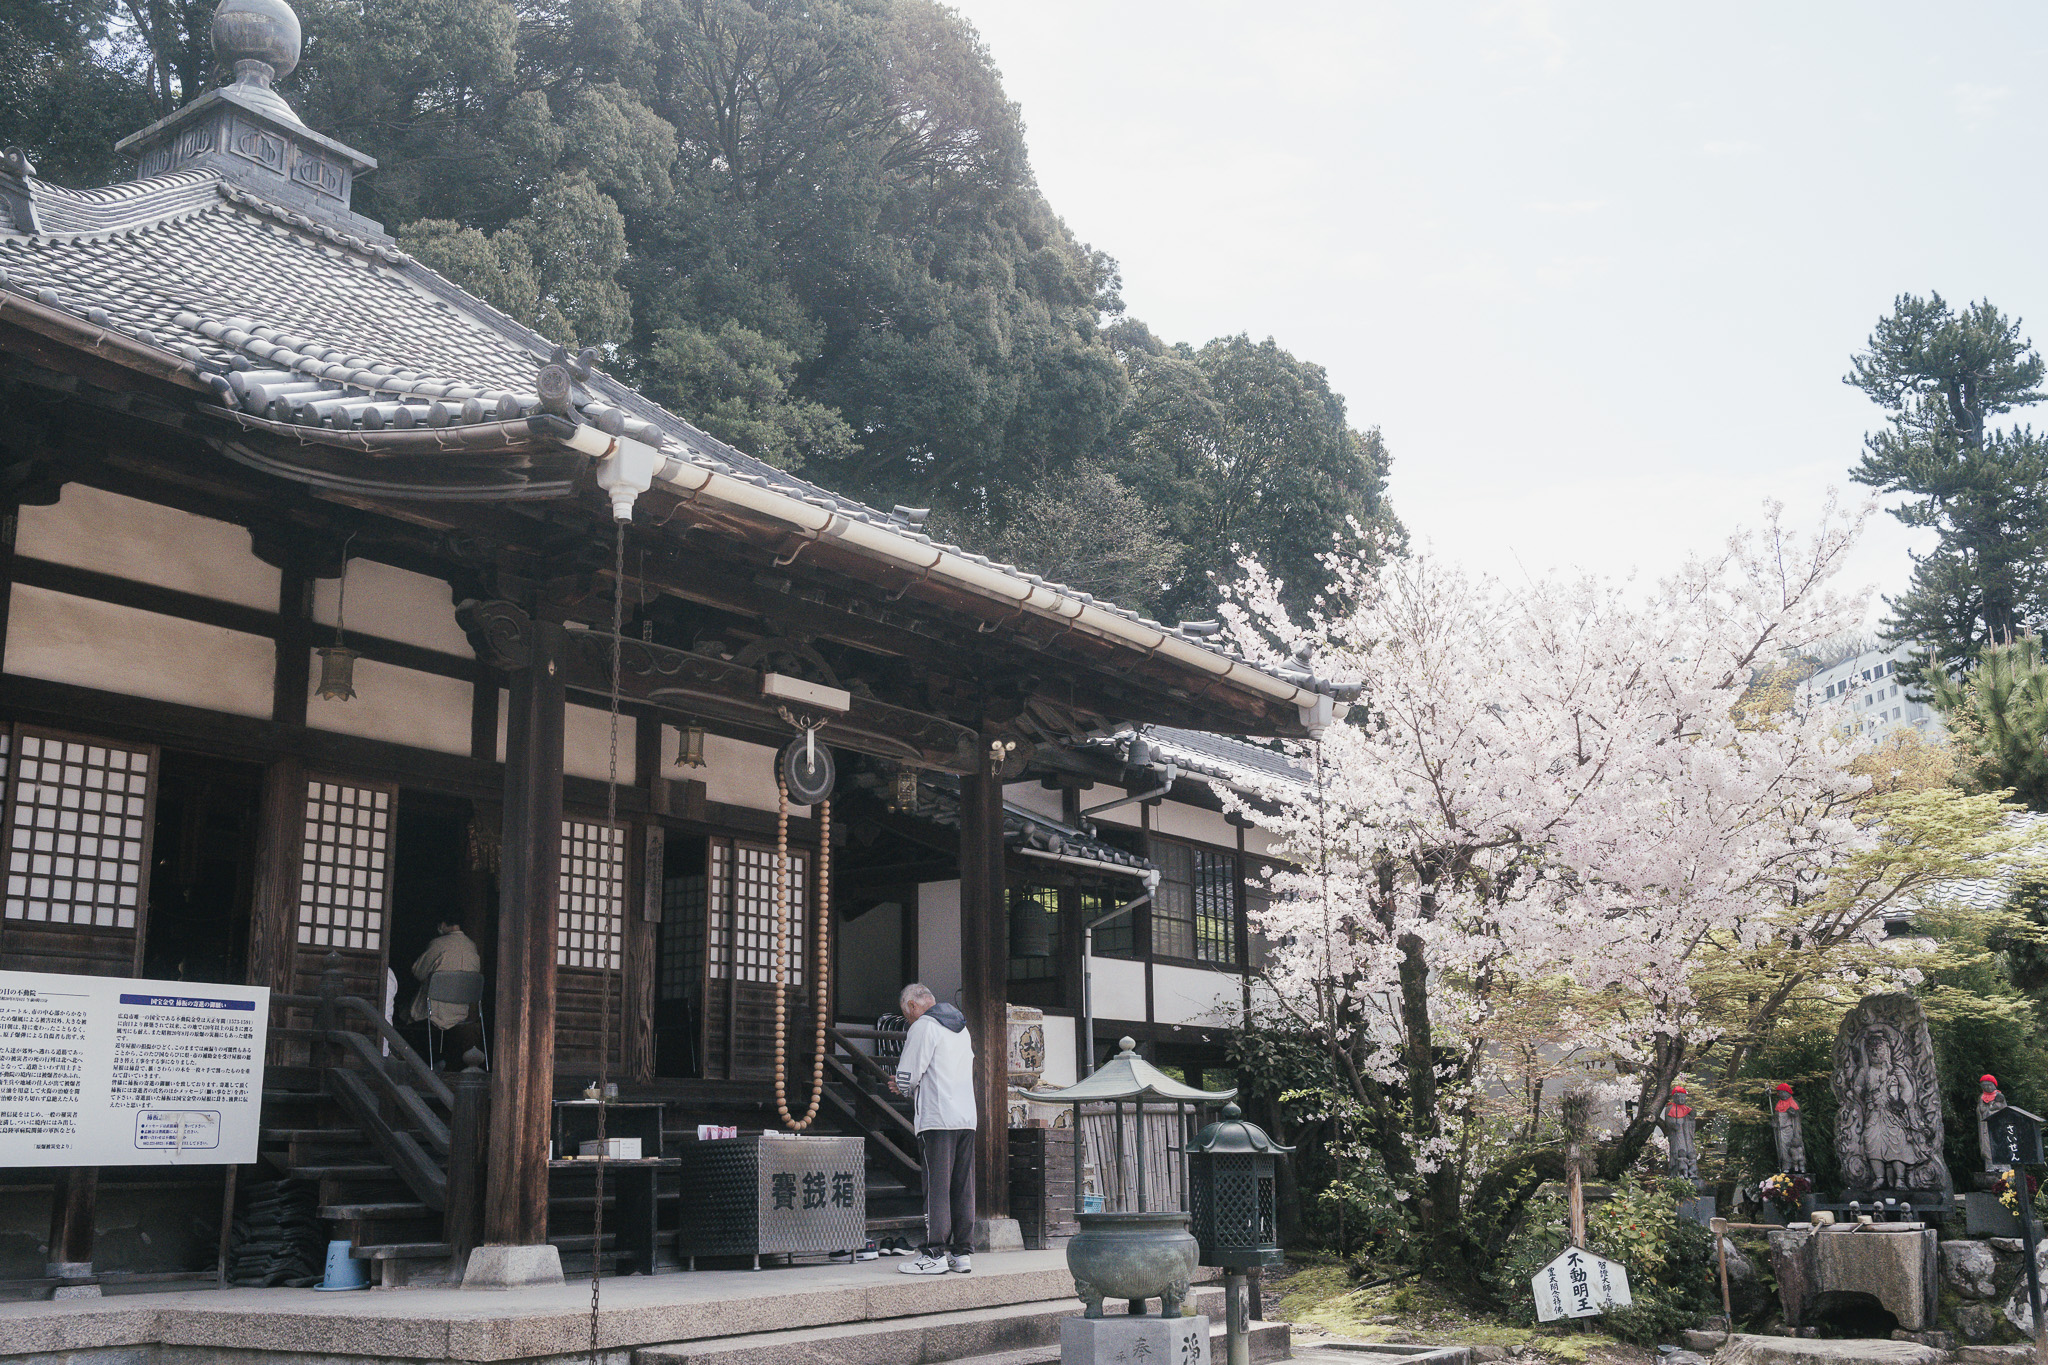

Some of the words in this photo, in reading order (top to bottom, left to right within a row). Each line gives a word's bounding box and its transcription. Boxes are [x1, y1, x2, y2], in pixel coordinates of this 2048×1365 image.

[2006, 1124, 2020, 1162] さいせん
[771, 1171, 856, 1212] 賽銭箱
[1567, 1252, 1593, 1312] 不動明王
[1132, 1336, 1152, 1363] 奉
